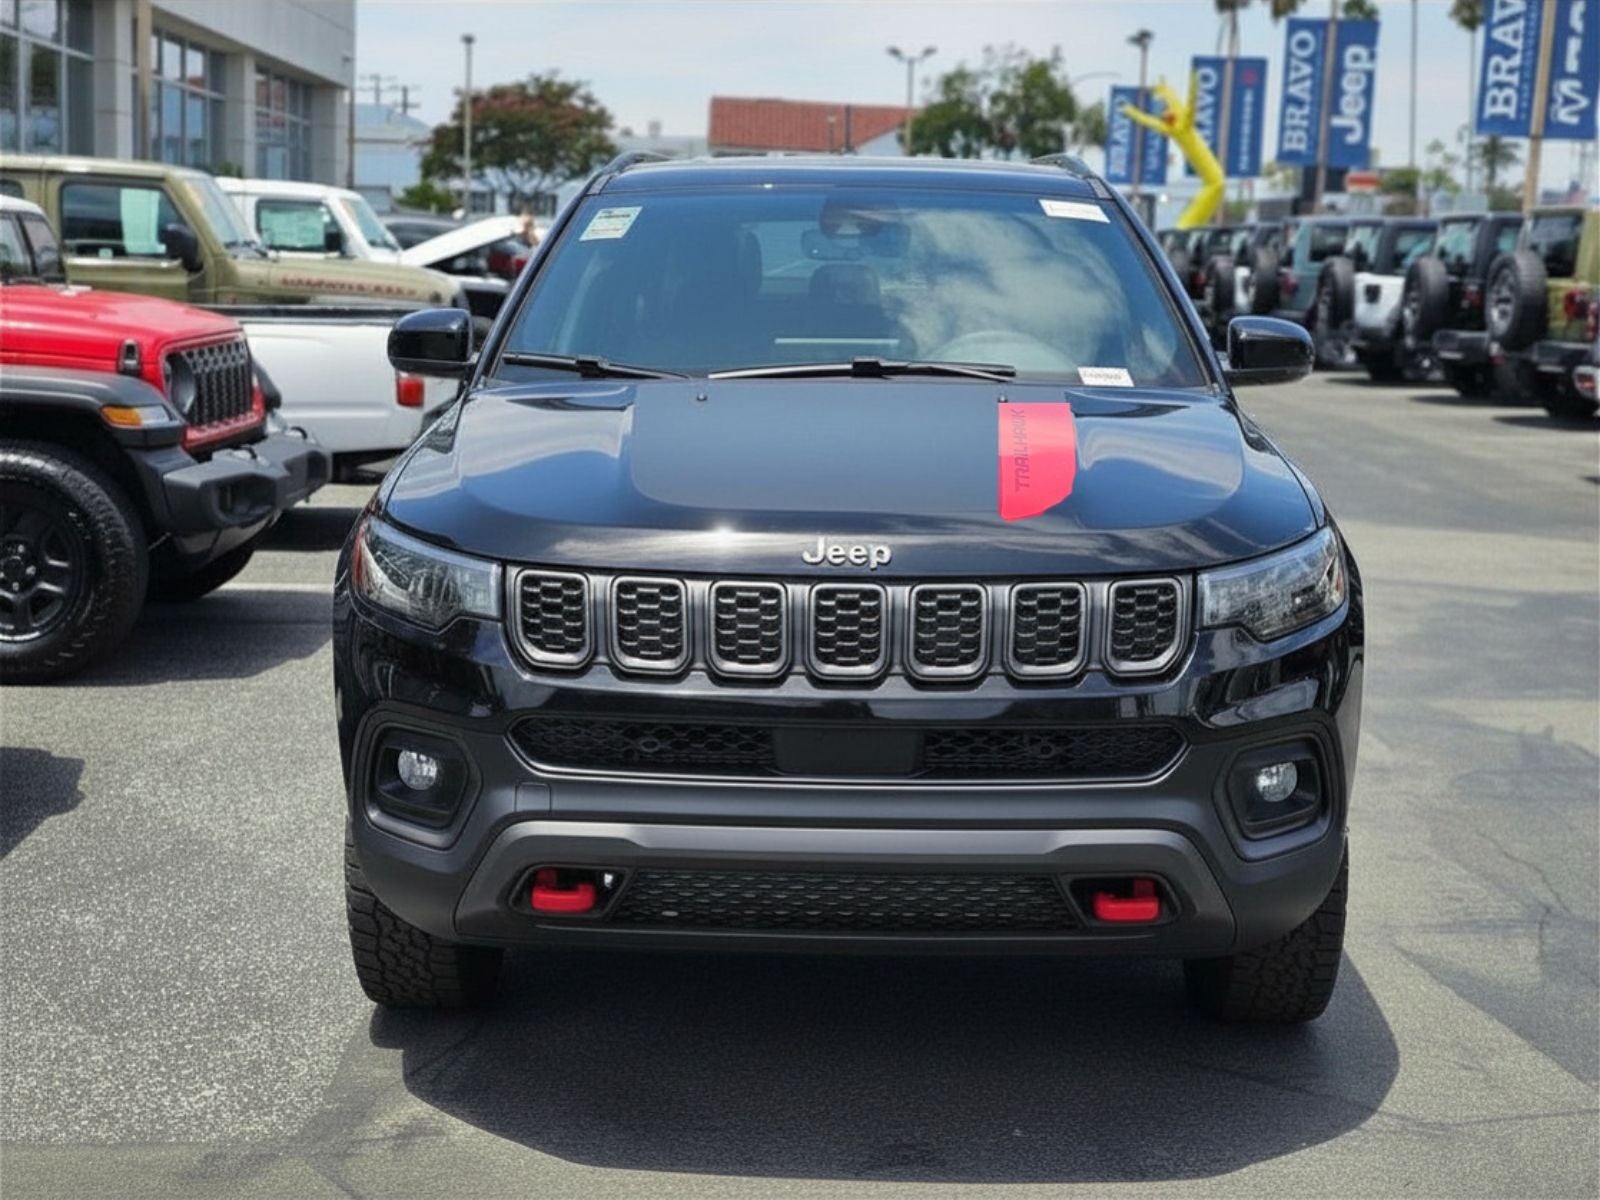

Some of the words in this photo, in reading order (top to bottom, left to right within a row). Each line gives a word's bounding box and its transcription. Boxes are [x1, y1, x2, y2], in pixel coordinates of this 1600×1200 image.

[1281, 30, 1316, 153] BRAVO
[1330, 44, 1376, 145] Jeep
[1010, 408, 1031, 493] TRAILHAWK
[801, 535, 892, 571] Jeep
